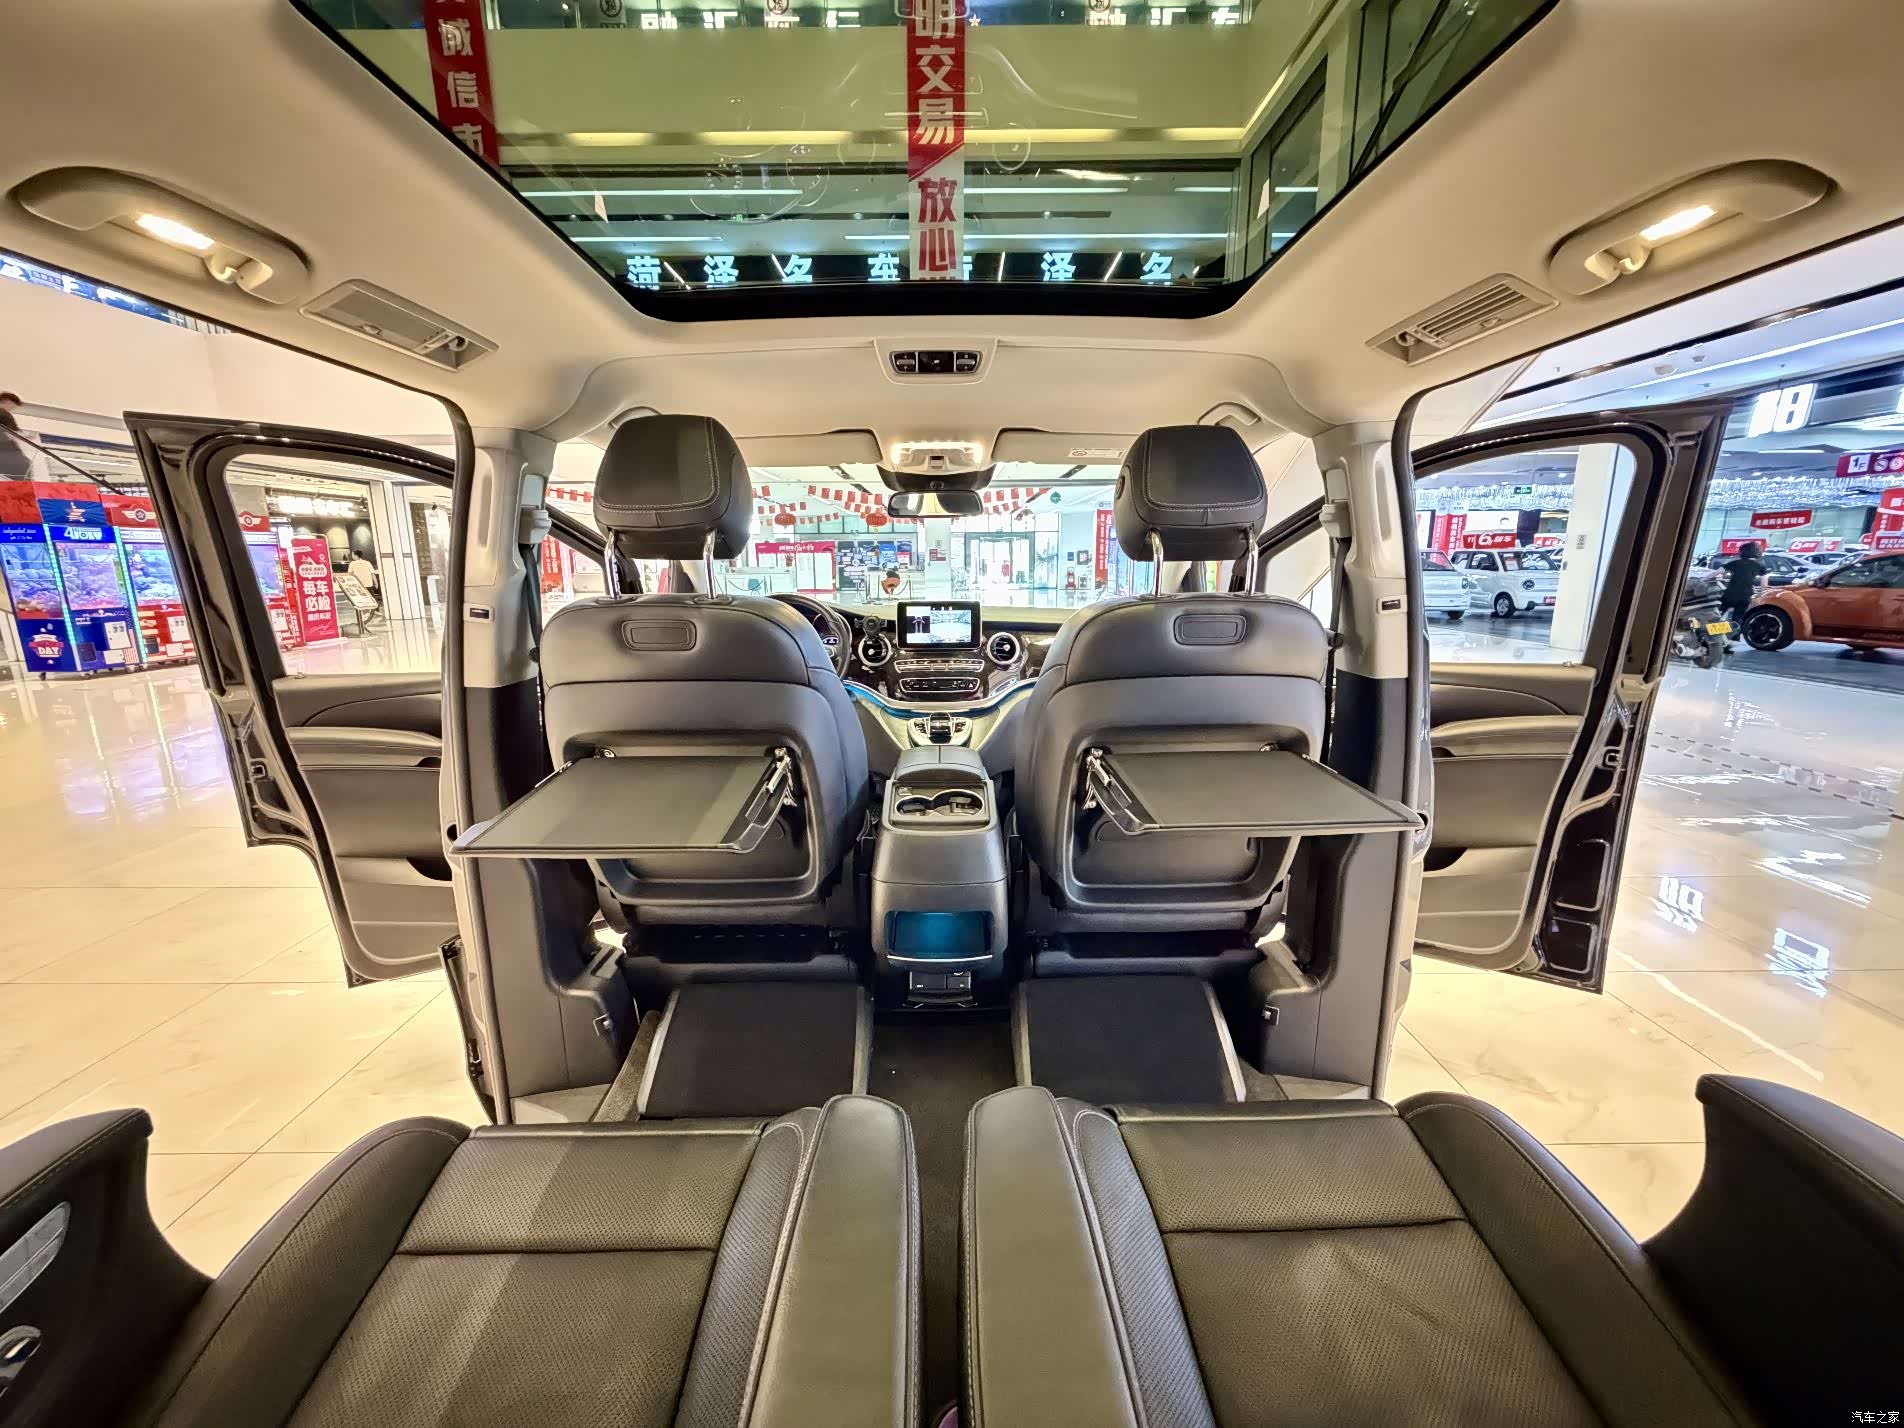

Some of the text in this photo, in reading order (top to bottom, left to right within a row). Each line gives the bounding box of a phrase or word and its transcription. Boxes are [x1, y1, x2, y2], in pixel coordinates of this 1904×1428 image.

[1747, 383, 1817, 438] 18
[1851, 457, 1866, 471] 1F
[302, 580, 329, 596] 每车
[37, 646, 59, 655] DAY
